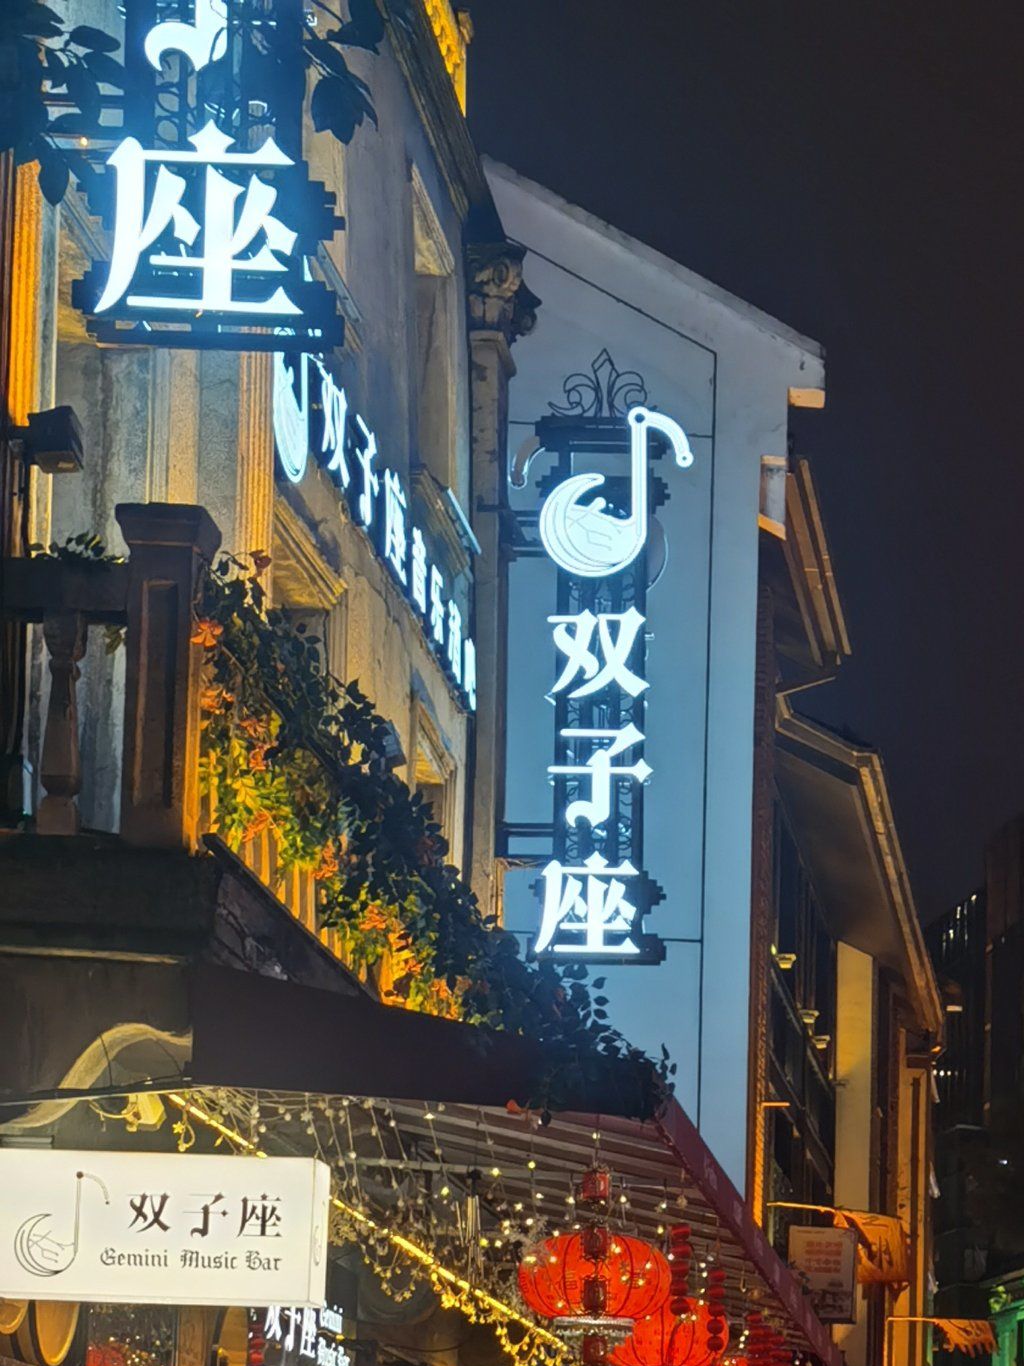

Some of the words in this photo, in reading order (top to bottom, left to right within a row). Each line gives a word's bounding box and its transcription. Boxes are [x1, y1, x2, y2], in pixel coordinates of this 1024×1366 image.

[535, 608, 653, 956] 双子座
[126, 1192, 283, 1239] 双子座
[100, 1247, 168, 1268] Gemini
[180, 1249, 238, 1270] Music
[245, 1250, 283, 1271] Bar
